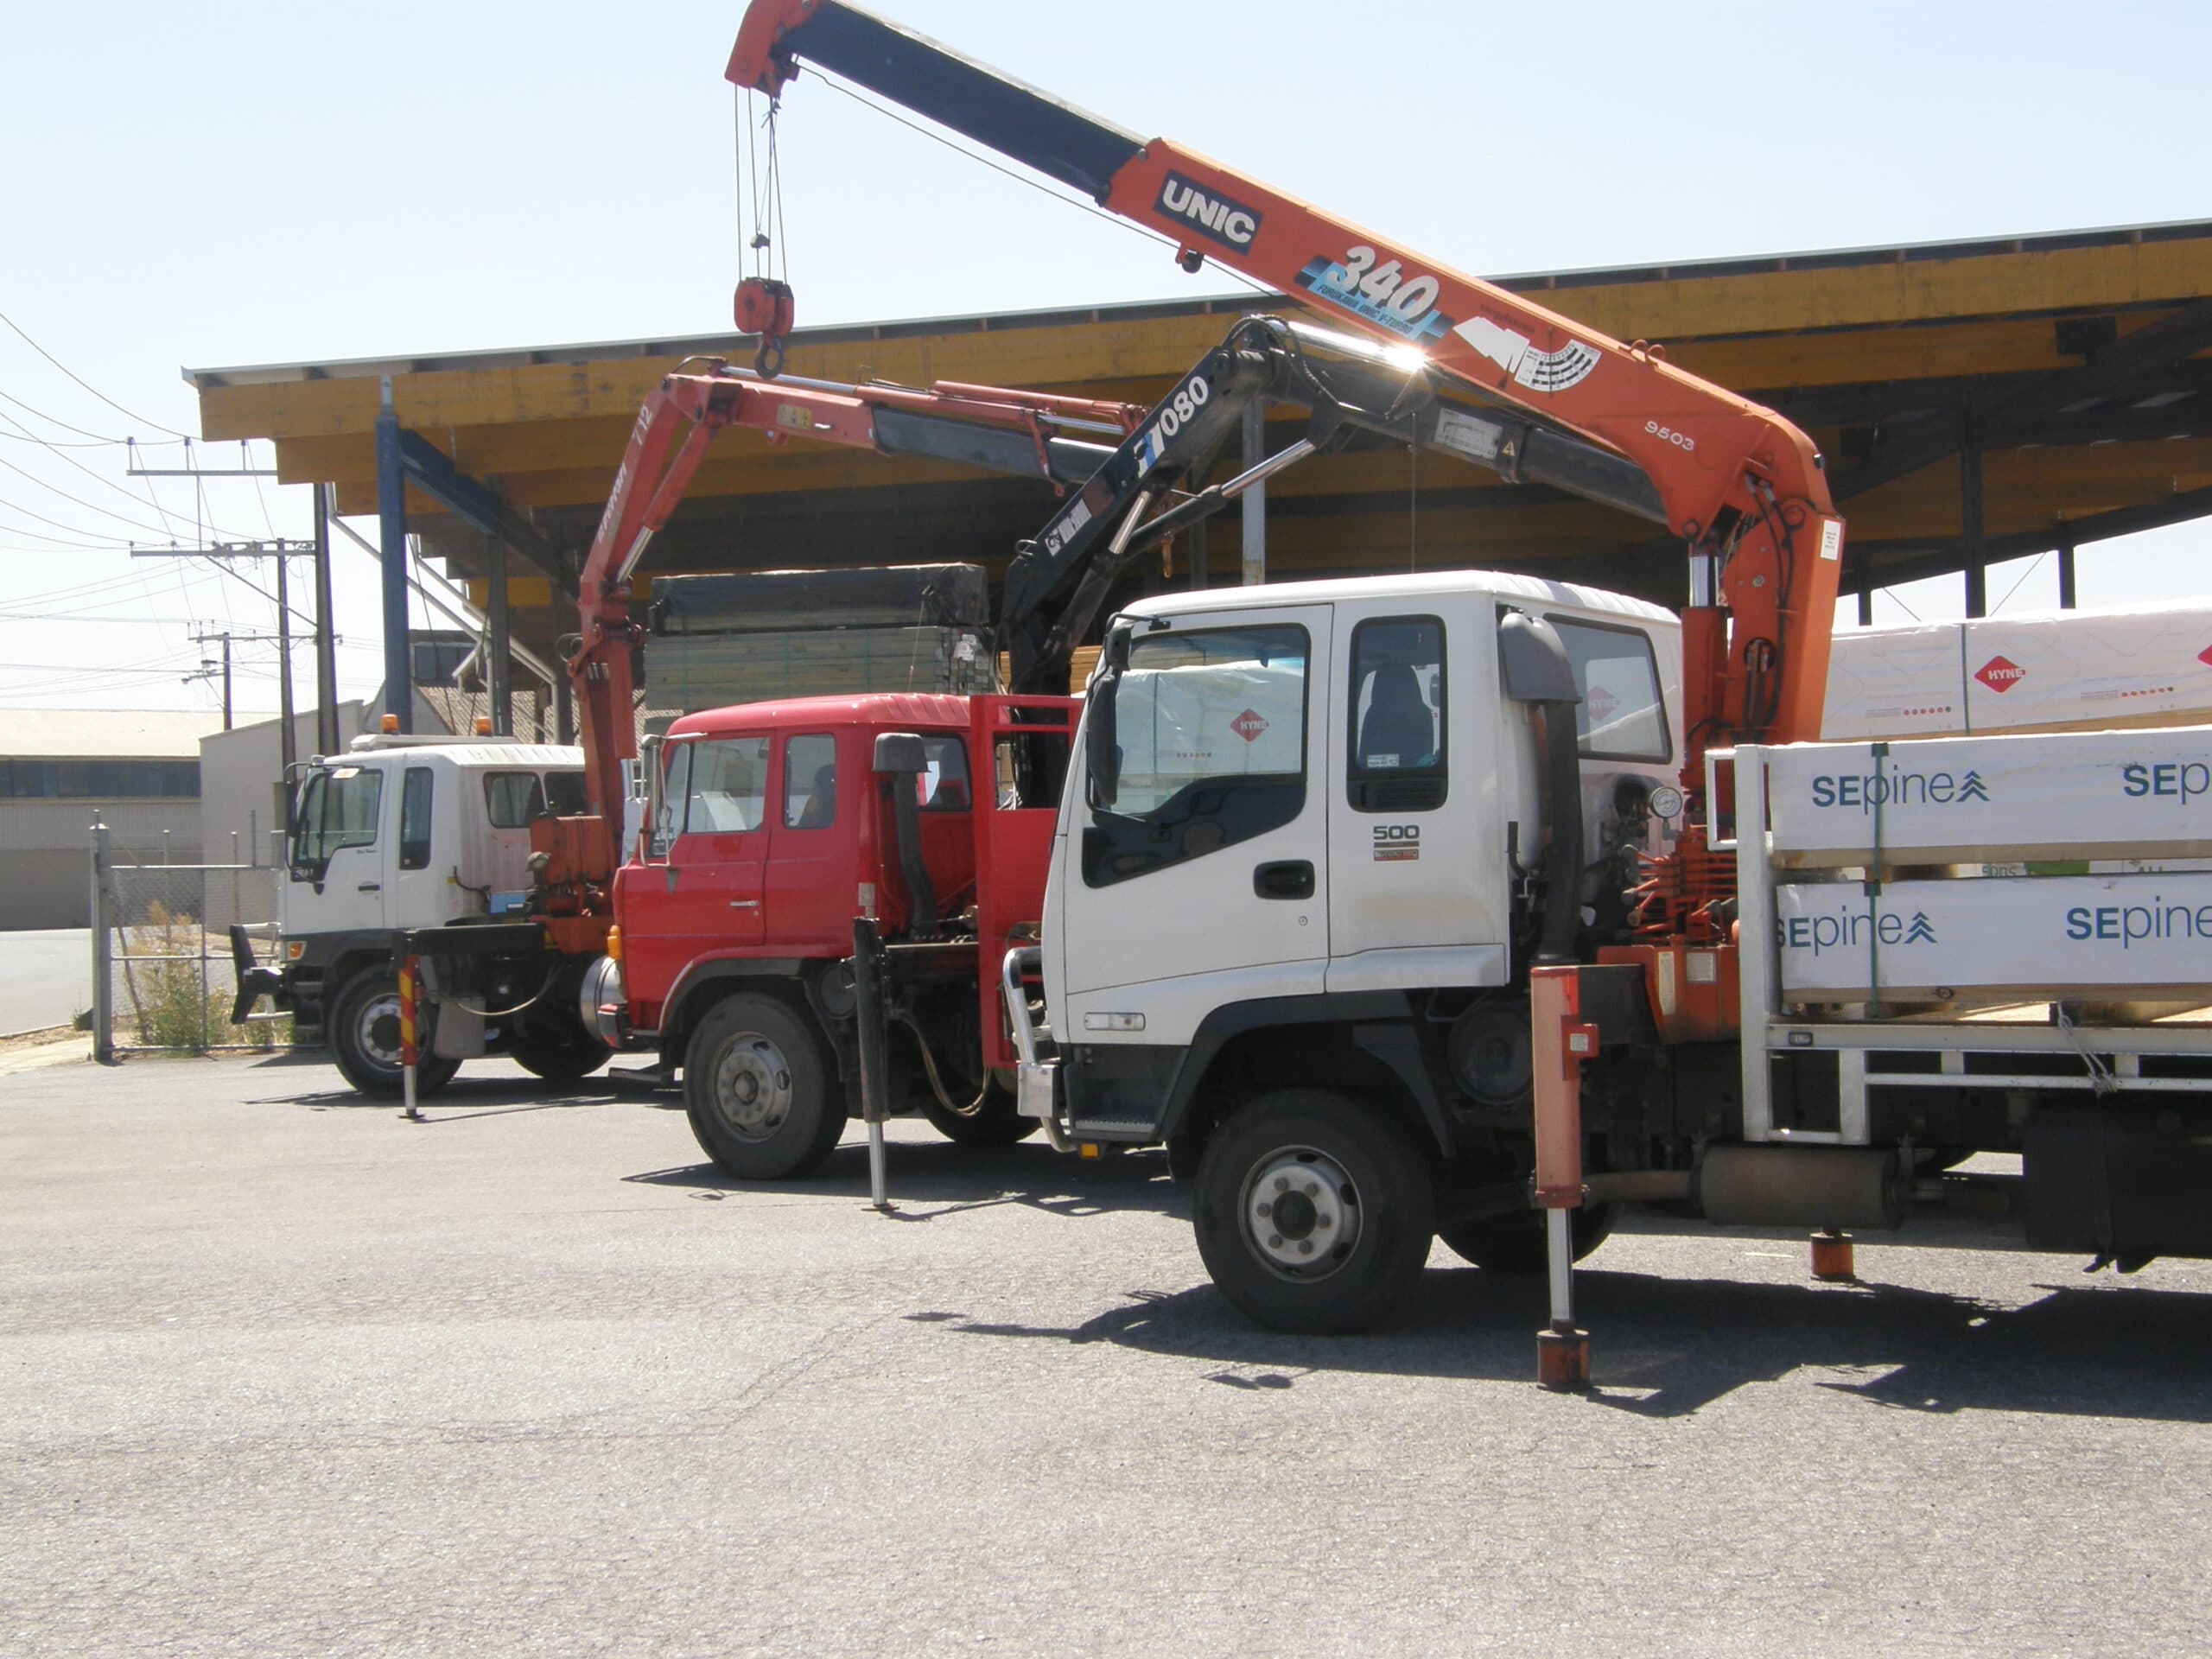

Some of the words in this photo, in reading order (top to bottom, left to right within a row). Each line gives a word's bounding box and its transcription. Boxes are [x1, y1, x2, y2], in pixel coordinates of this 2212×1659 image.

[1162, 179, 1255, 244] UNIC
[1326, 245, 1440, 324] 340
[1644, 420, 1694, 451] 9503
[1987, 667, 2026, 681] HYNE
[1374, 824, 1420, 840] 500
